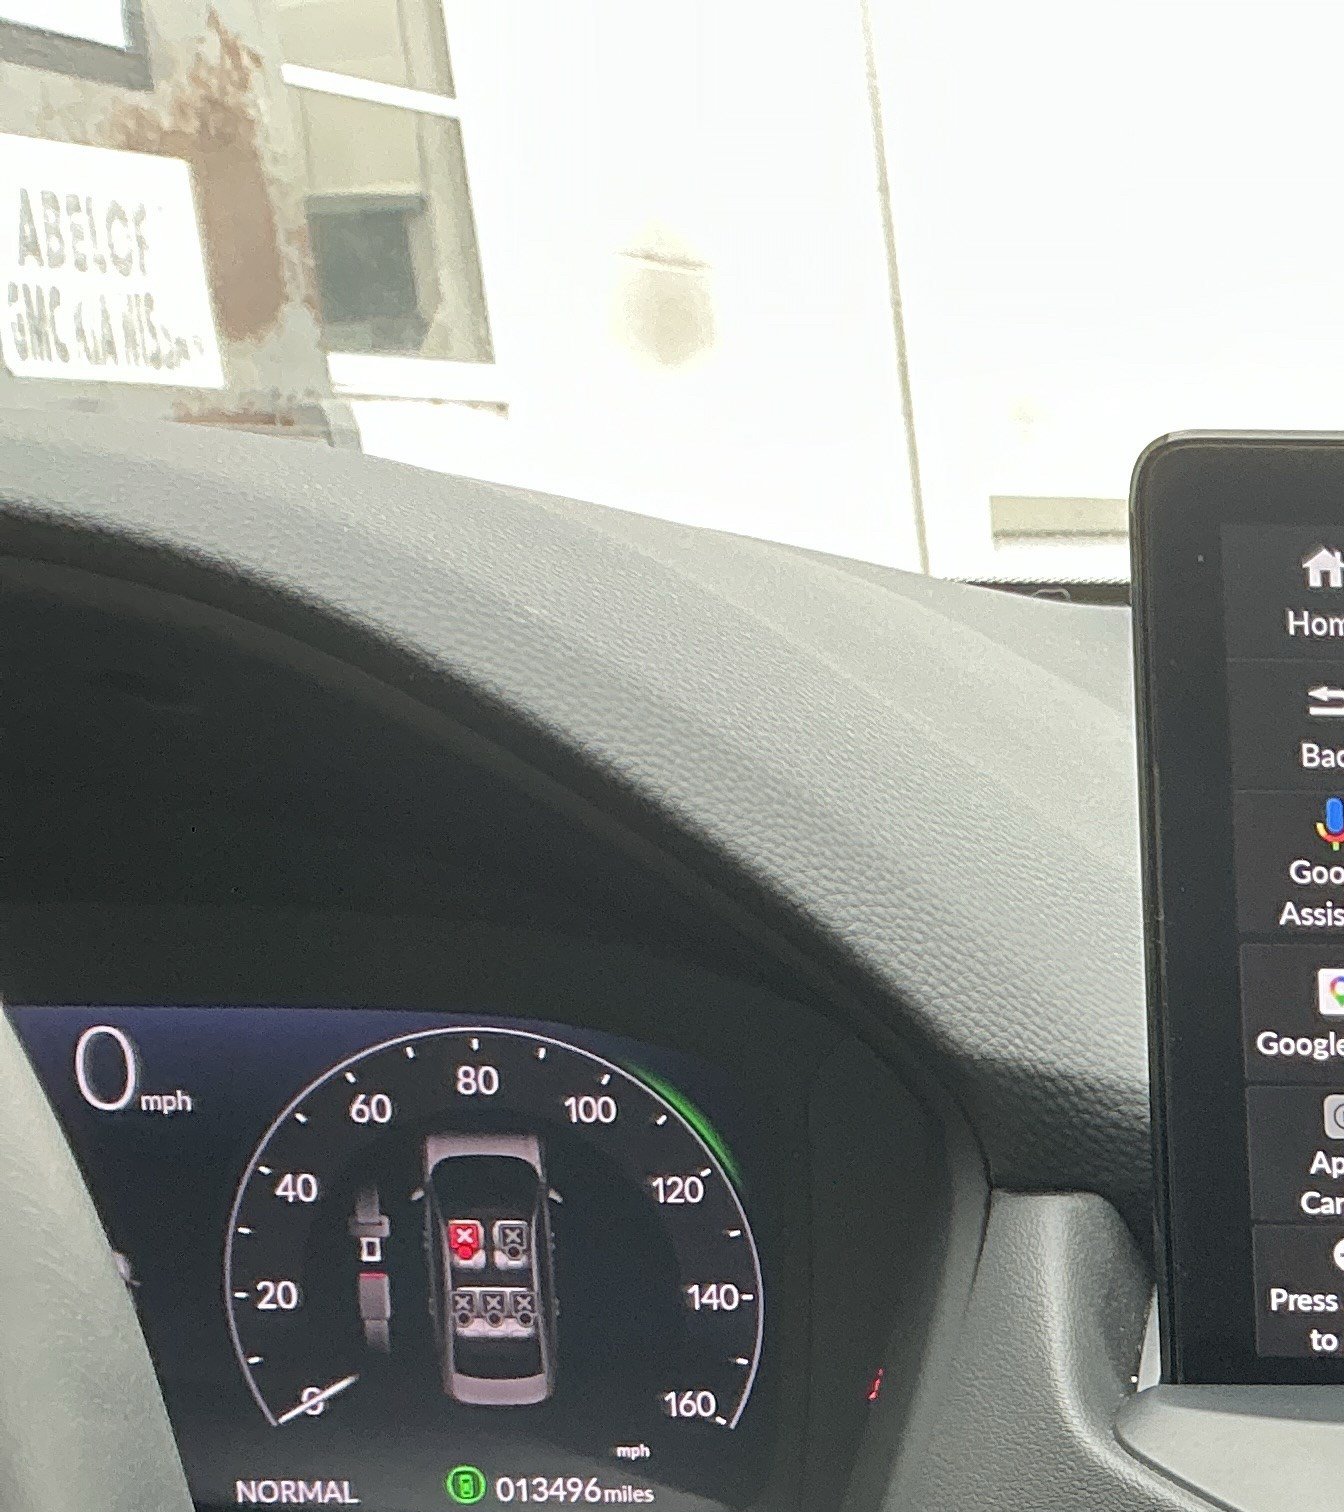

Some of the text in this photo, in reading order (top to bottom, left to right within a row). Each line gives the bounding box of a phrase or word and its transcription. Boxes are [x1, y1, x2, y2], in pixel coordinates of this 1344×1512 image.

[75, 1025, 137, 1111] 0
[456, 1065, 499, 1095] 80
[140, 1089, 192, 1115] mph
[349, 1093, 393, 1124] 60
[564, 1095, 617, 1123] 100
[274, 1173, 318, 1203] 40
[651, 1175, 705, 1205] 120
[256, 1280, 299, 1310] 20
[687, 1283, 740, 1311] 140
[1270, 1287, 1339, 1312] Press
[1309, 1329, 1337, 1353] to
[664, 1390, 716, 1418] 160
[616, 1443, 651, 1461] mph
[235, 1480, 361, 1504] NORMAL
[495, 1476, 655, 1503] 013496 miles
